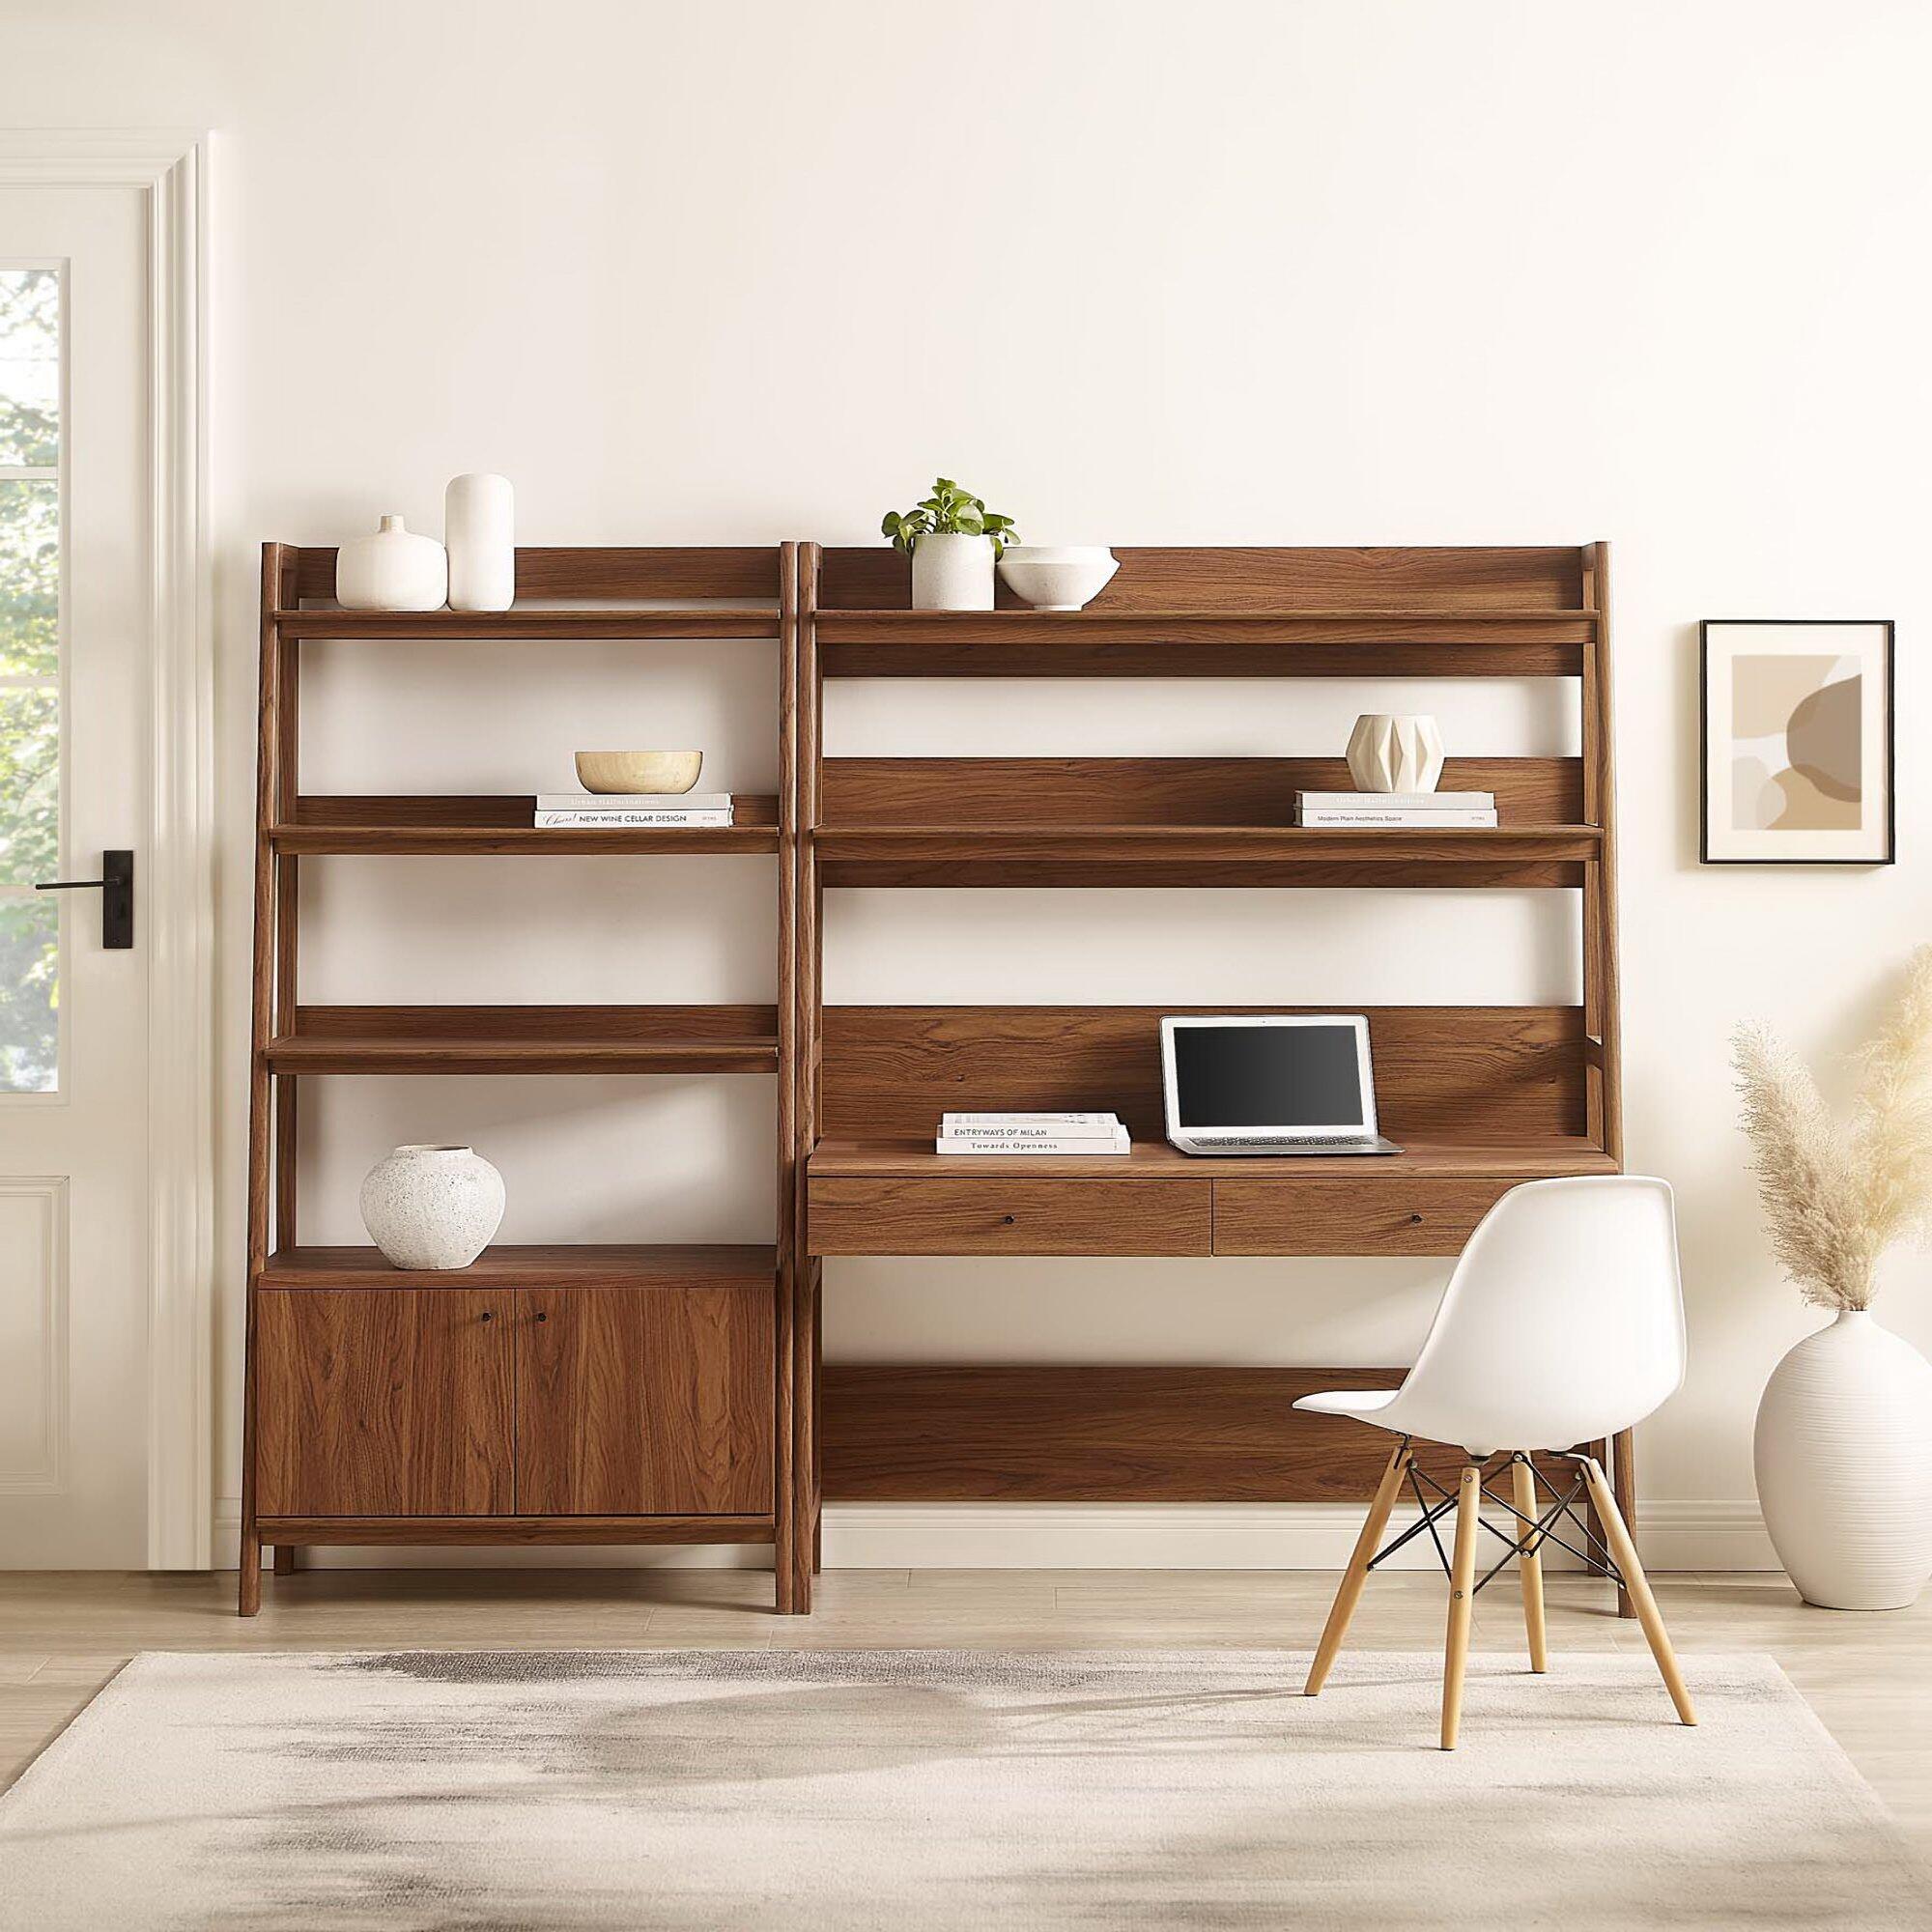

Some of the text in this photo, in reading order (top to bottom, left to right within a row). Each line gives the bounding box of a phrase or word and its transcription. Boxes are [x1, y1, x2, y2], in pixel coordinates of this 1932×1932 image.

[579, 814, 599, 823] NEW
[600, 814, 622, 823] WINE
[624, 814, 654, 823] CELLAR
[656, 814, 687, 823] DESIGN
[953, 1128, 1047, 1137] ENTRYWAYS OF MILAN
[1012, 1142, 1058, 1151] Openness
